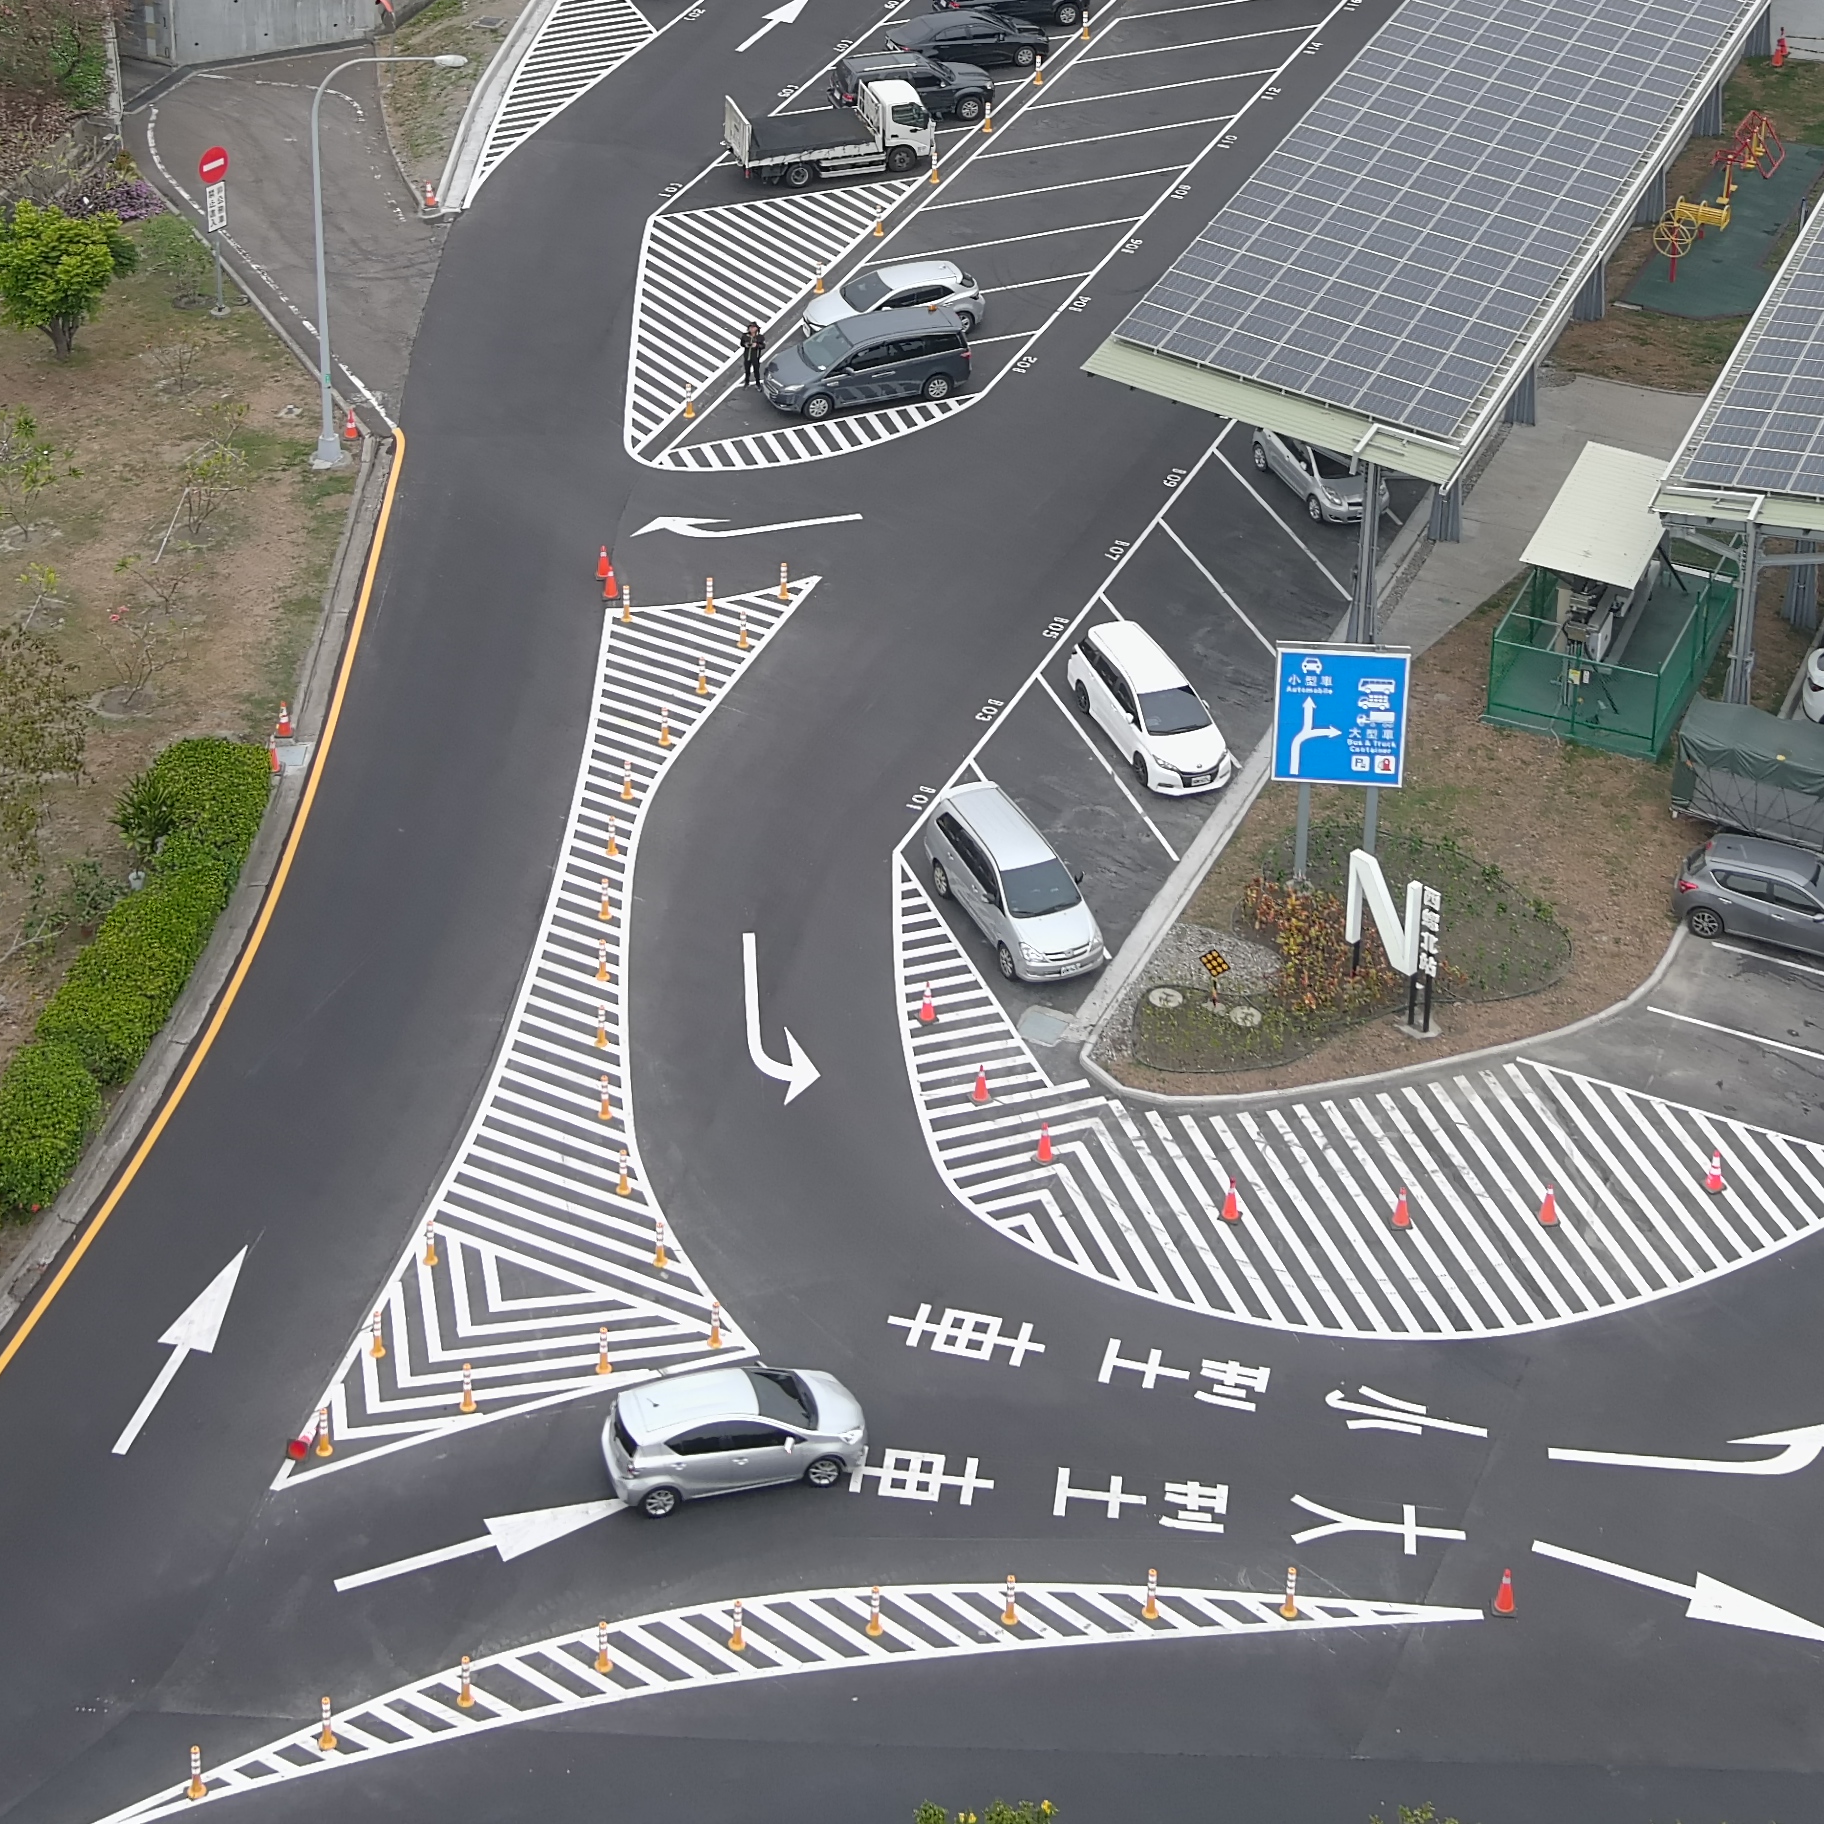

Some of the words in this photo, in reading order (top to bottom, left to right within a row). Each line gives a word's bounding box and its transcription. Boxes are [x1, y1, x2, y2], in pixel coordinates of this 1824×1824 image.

[1068, 296, 1091, 312] B04
[1013, 356, 1037, 373] B02
[1163, 468, 1187, 487] B09
[1105, 540, 1130, 560] B07
[1042, 617, 1069, 639] B05
[1288, 674, 1334, 686] 小型車
[1286, 686, 1334, 695] Automobile
[975, 699, 1004, 721] B03
[1348, 728, 1394, 740] 大型車
[1349, 746, 1392, 754] Container
[1373, 740, 1397, 748] Truck
[906, 786, 936, 810] B01
[1345, 848, 1423, 976] N
[1419, 885, 1442, 978] 西螺北站
